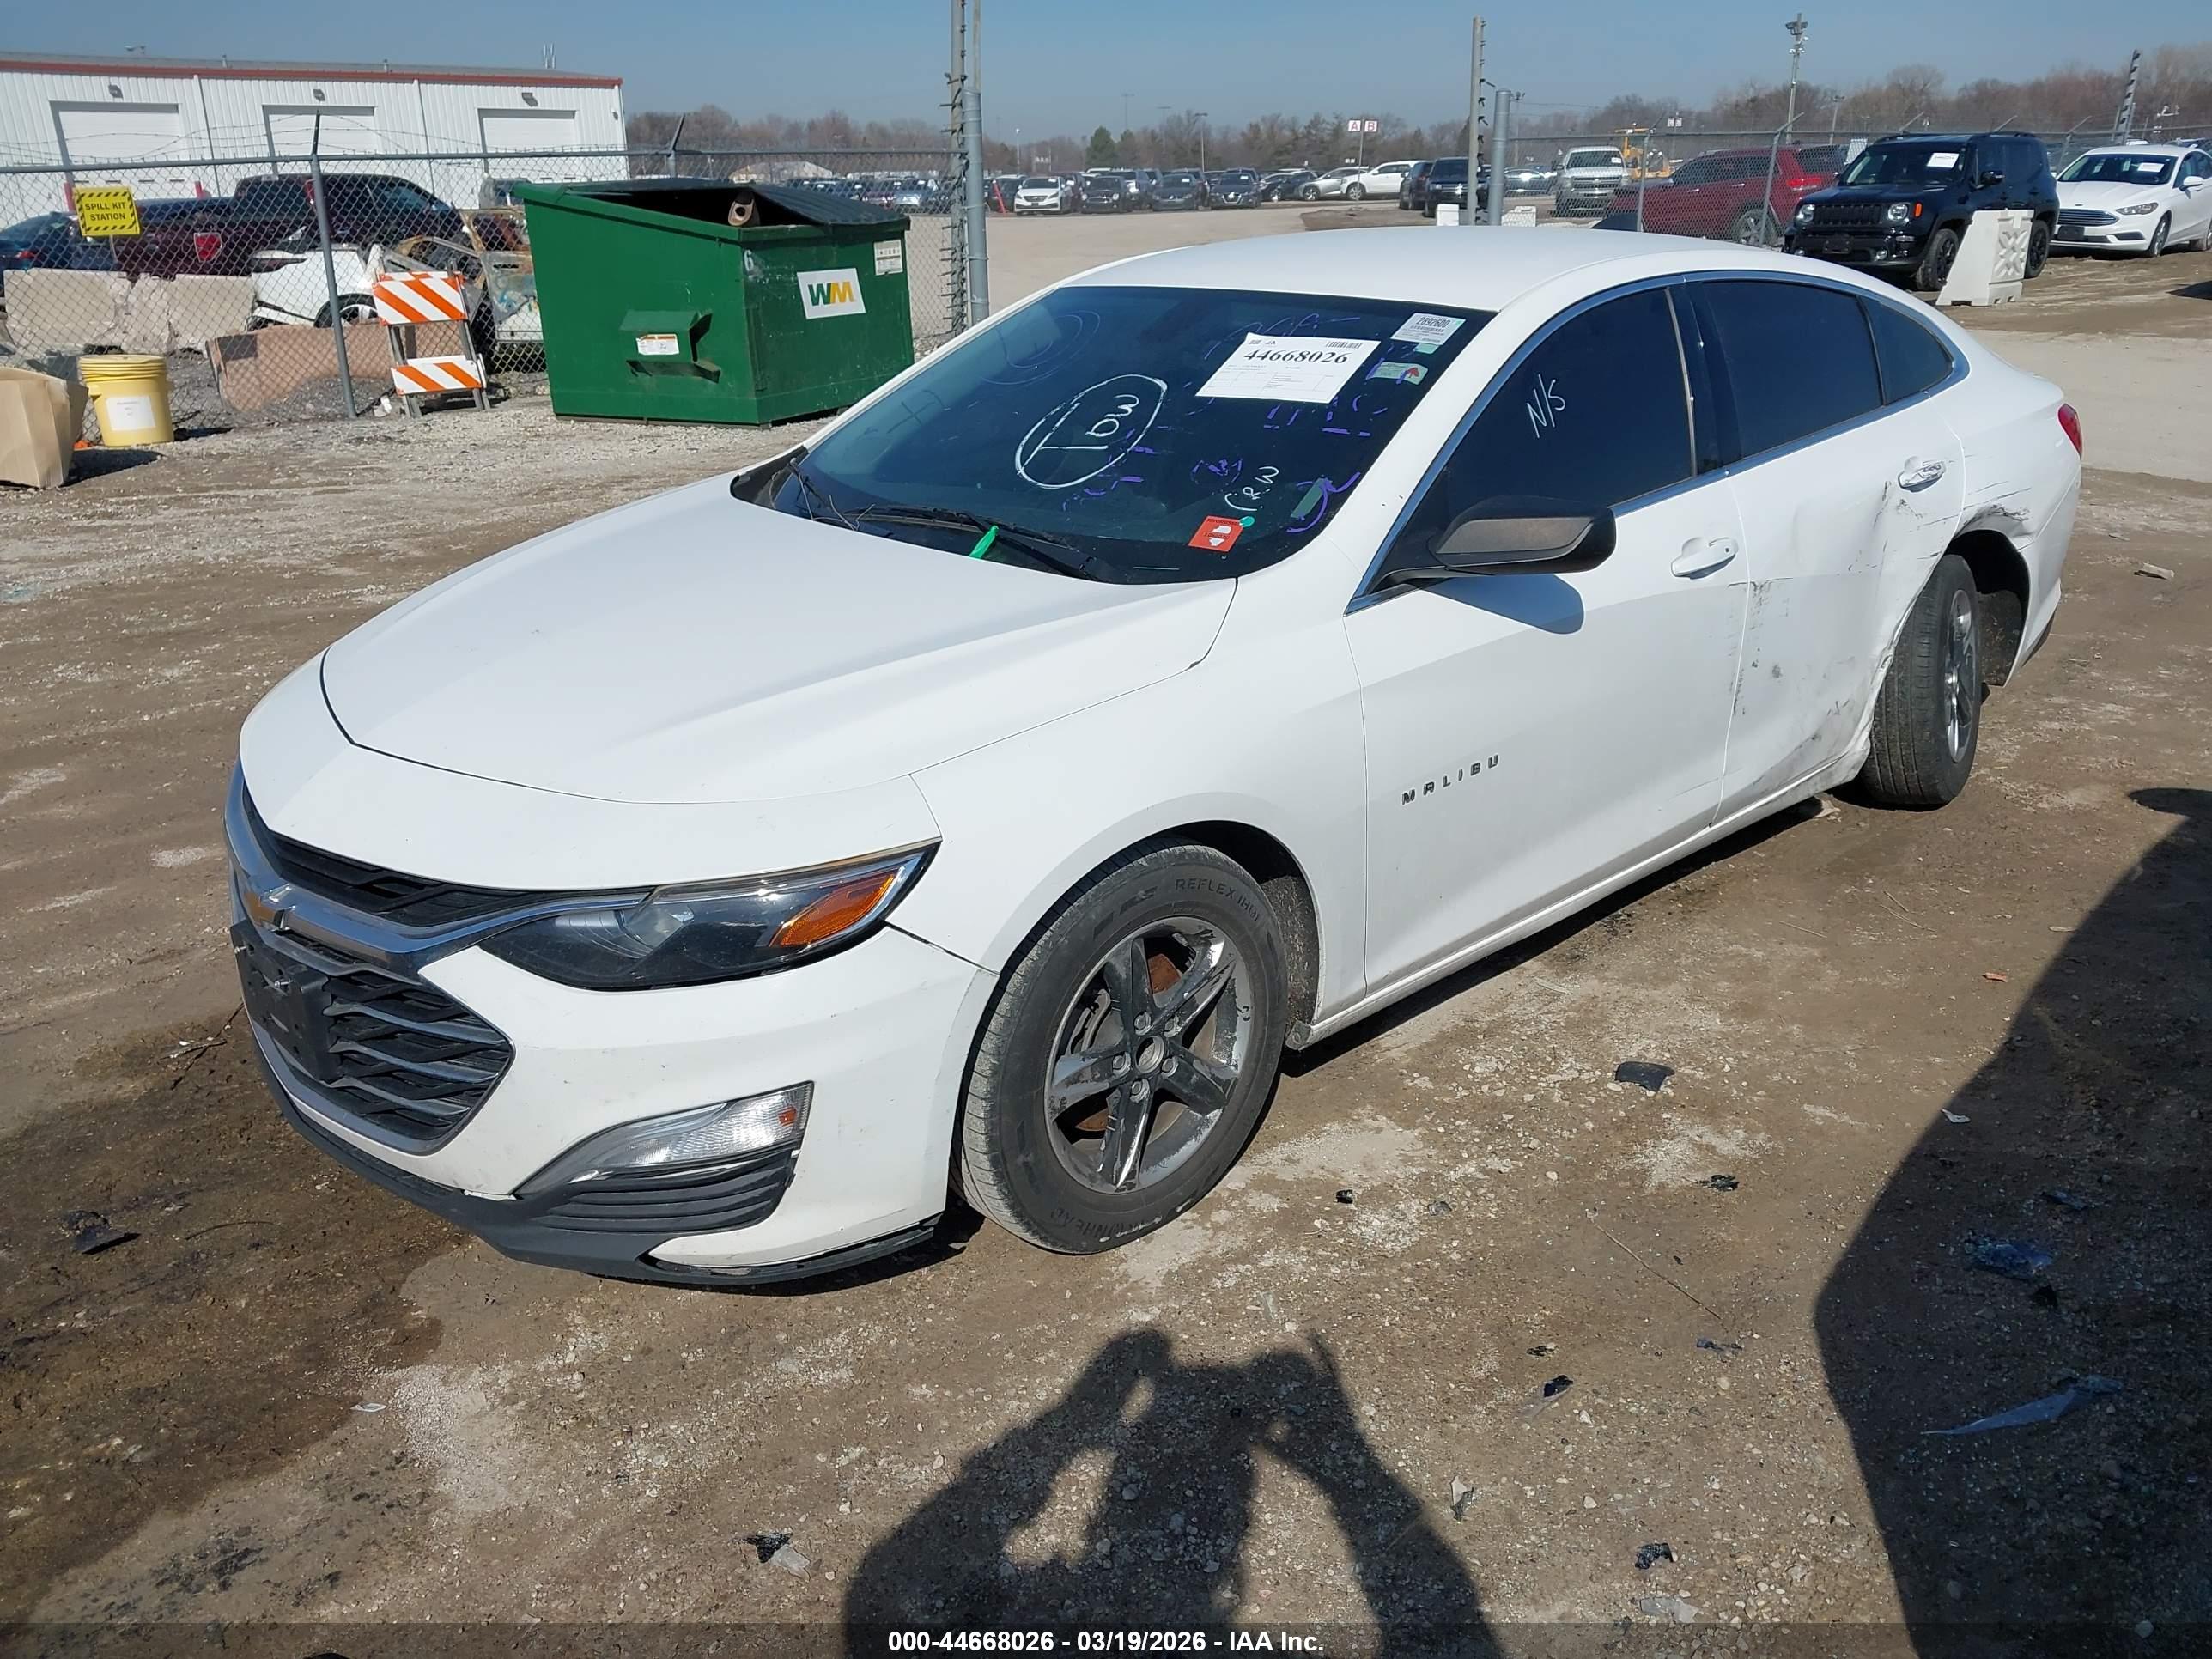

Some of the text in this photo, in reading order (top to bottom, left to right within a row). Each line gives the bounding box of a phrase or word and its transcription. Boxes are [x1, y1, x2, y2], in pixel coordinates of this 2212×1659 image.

[112, 201, 126, 210] KIT
[807, 281, 855, 307] WM
[1243, 349, 1352, 364] 44668026
[1401, 754, 1498, 805] MALIBU
[1175, 878, 1237, 900] REFLEX
